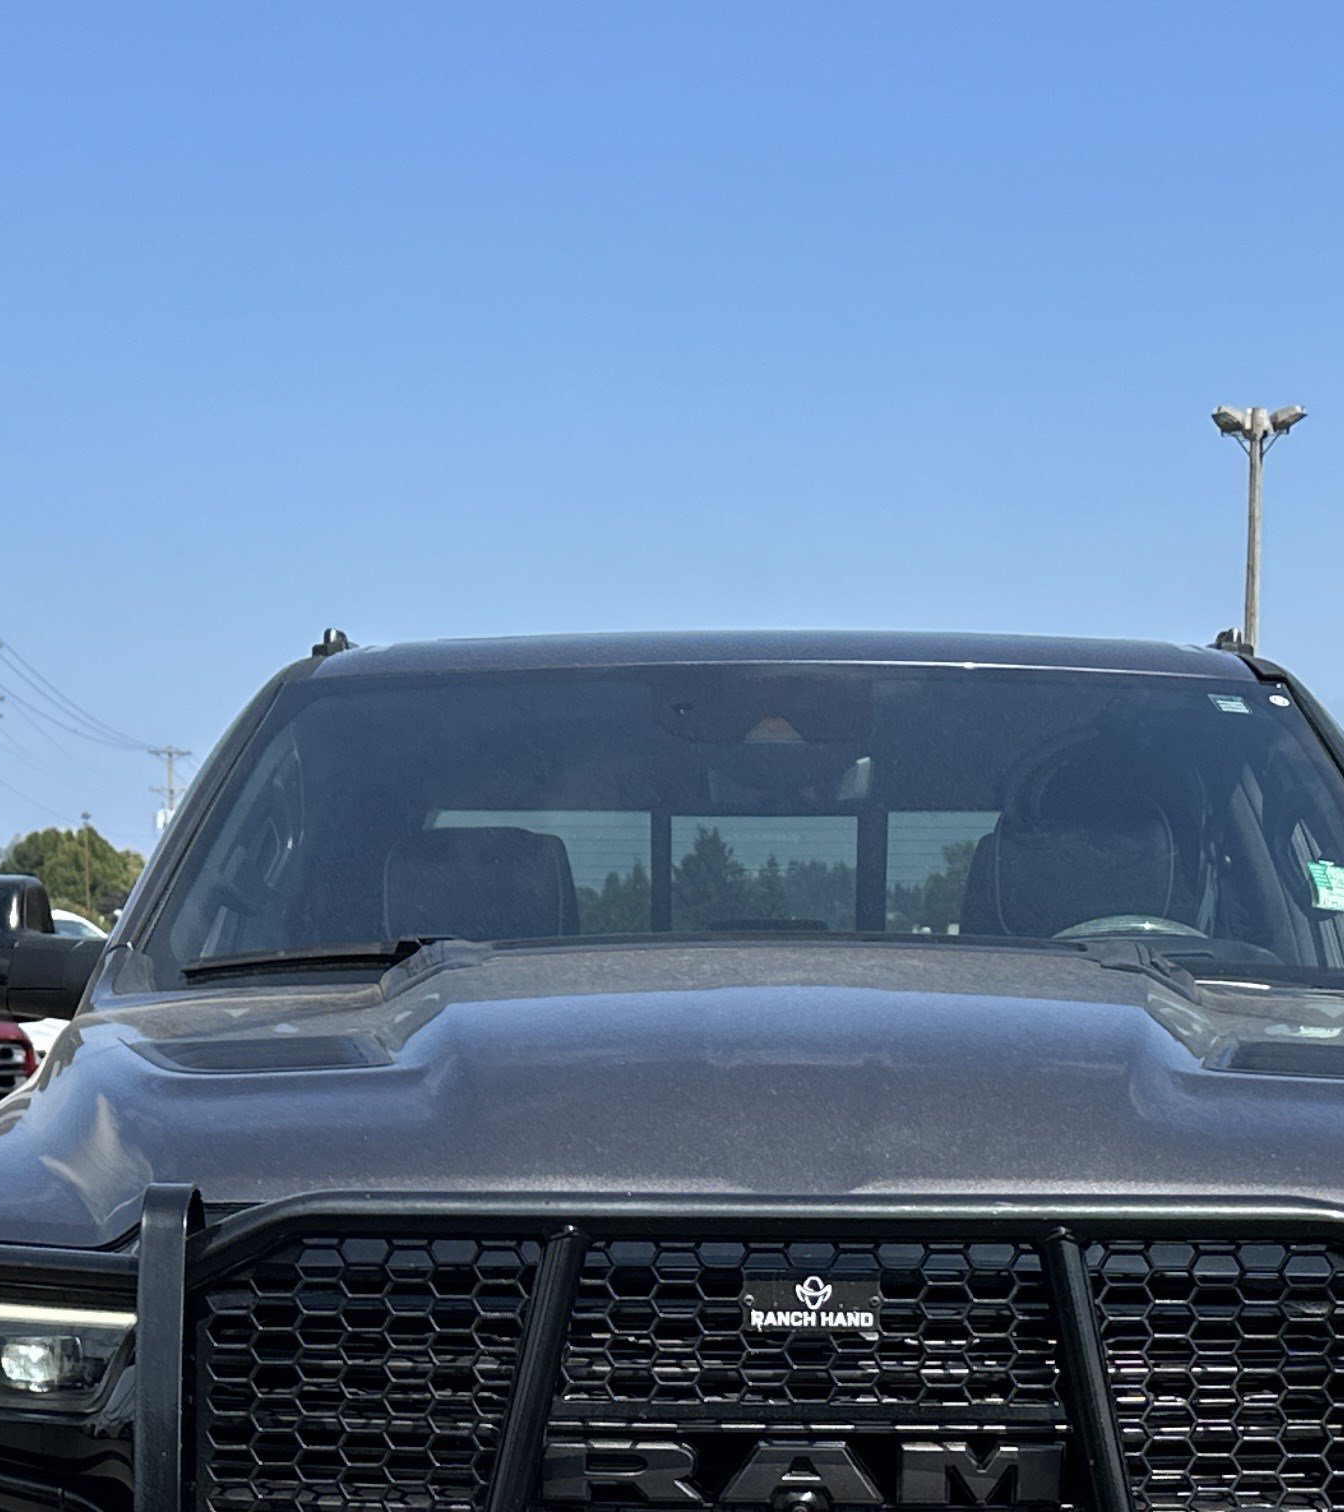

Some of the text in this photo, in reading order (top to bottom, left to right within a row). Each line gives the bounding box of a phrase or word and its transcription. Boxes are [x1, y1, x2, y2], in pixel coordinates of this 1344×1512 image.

[751, 1310, 874, 1332] RANCH HAND
[542, 1440, 1067, 1504] RAM
